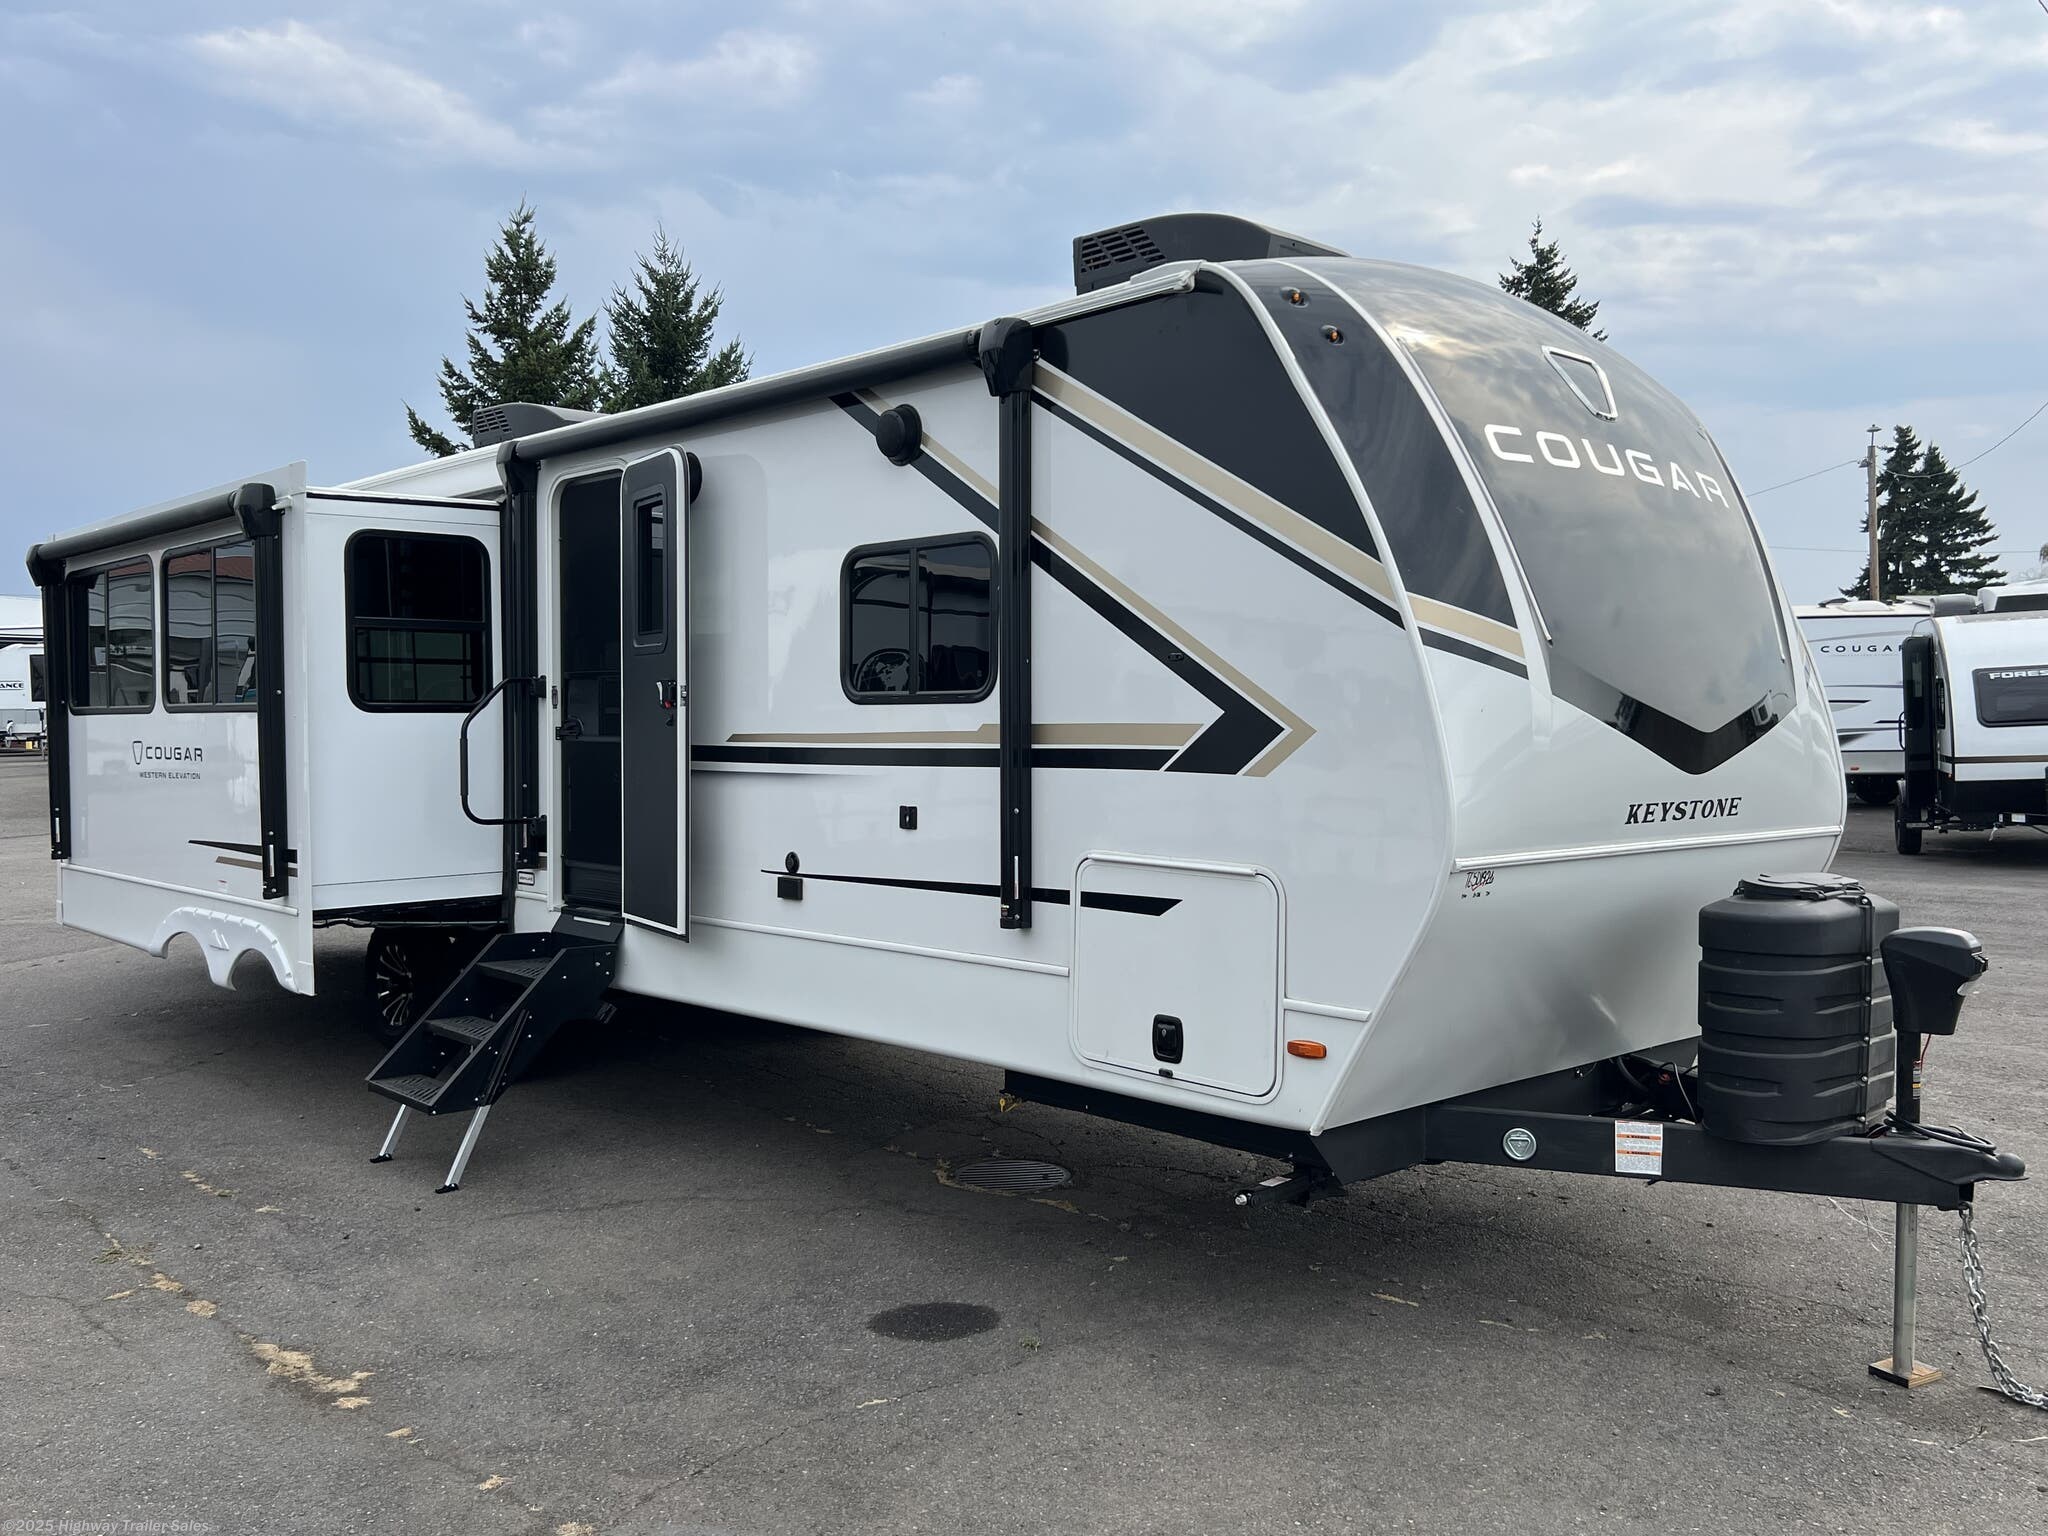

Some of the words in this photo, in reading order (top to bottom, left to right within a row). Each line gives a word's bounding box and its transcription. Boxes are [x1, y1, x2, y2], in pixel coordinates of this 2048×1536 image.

[1484, 423, 1729, 508] COUGAR
[145, 746, 203, 762] COUGAR
[140, 771, 167, 779] WESTERN
[168, 772, 201, 780] ELEVATION
[1624, 797, 1742, 825] KEYSTONE
